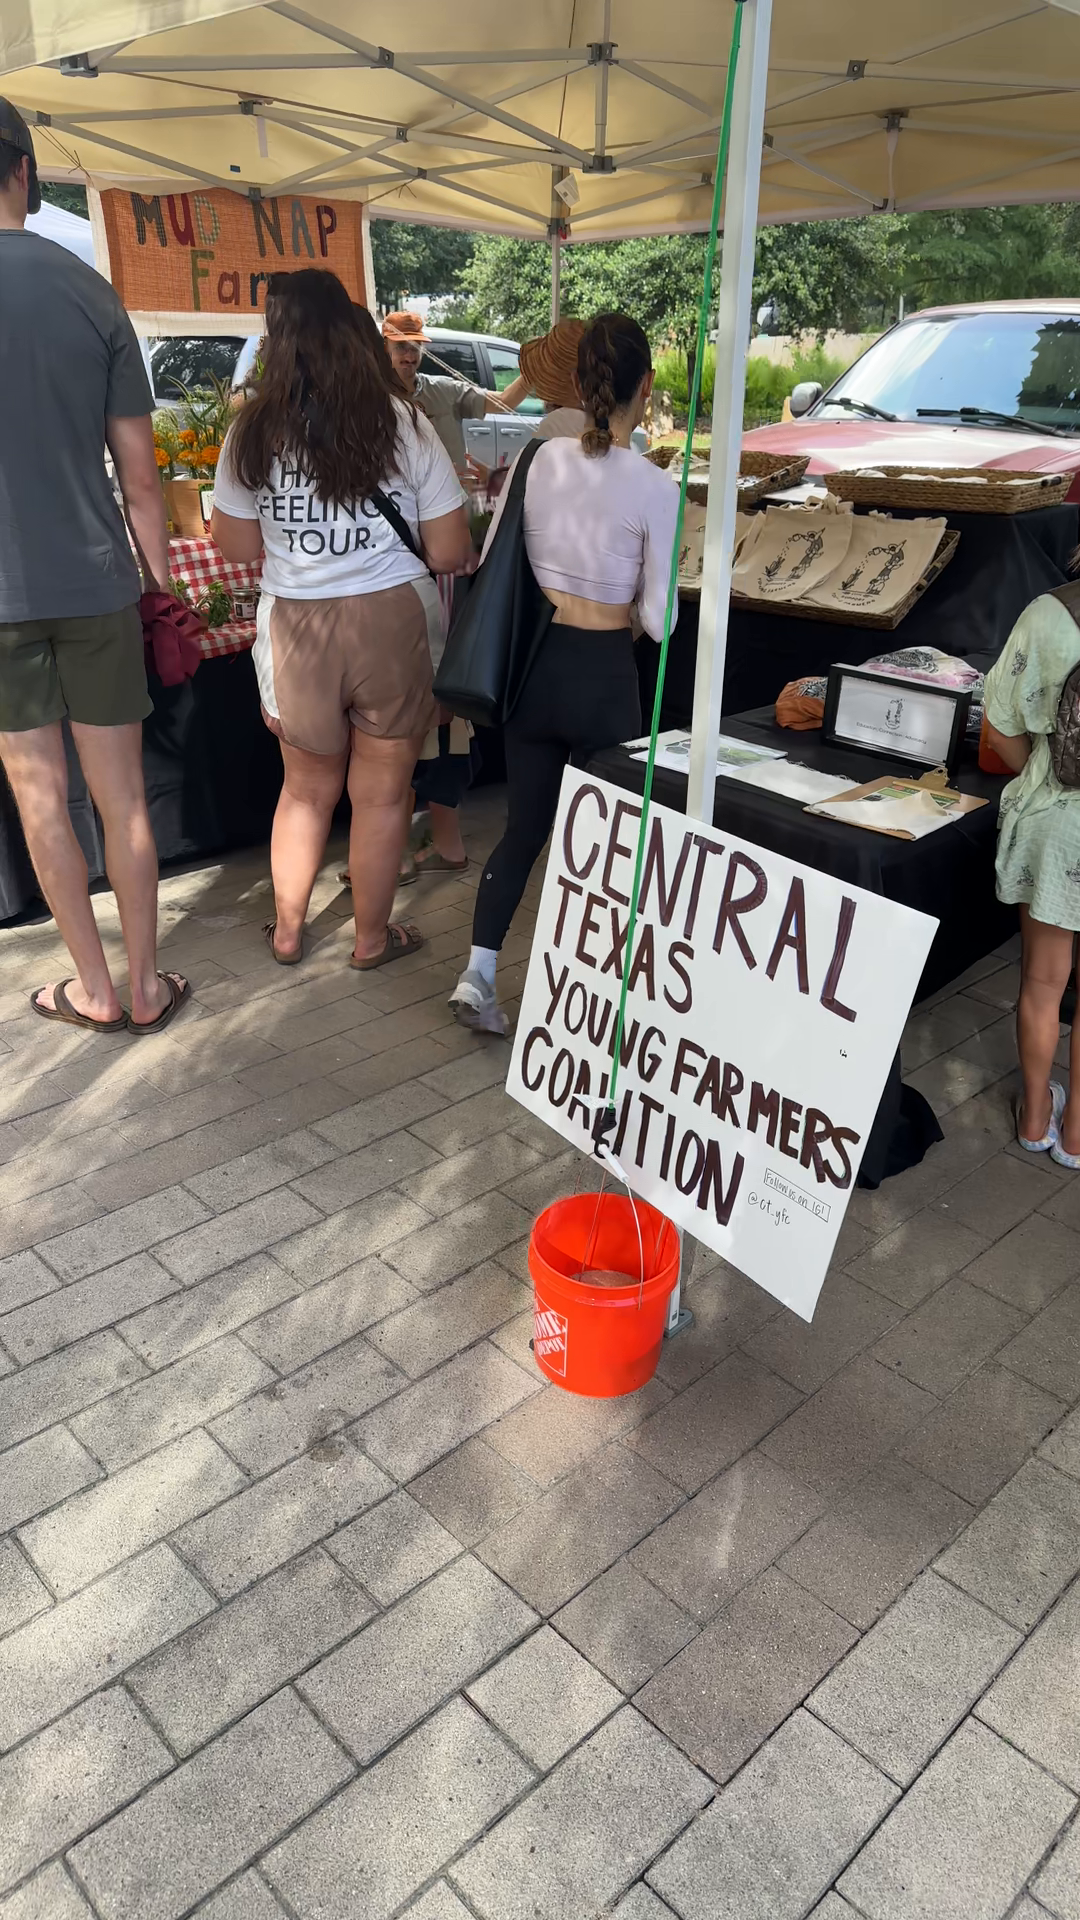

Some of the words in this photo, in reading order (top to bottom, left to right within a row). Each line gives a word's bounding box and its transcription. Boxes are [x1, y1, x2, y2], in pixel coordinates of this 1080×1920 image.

[130, 192, 221, 247] MUD
[250, 197, 337, 259] NAP
[190, 249, 270, 311] Far
[282, 527, 377, 556] TOUR.
[563, 783, 857, 1023] CENTRAL
[557, 875, 694, 1014] TEXAS
[544, 952, 666, 1083] YOUNG
[670, 1038, 861, 1190] FARMERS
[765, 1172, 789, 1194] Follow
[788, 1188, 797, 1201] us
[798, 1195, 809, 1209] on
